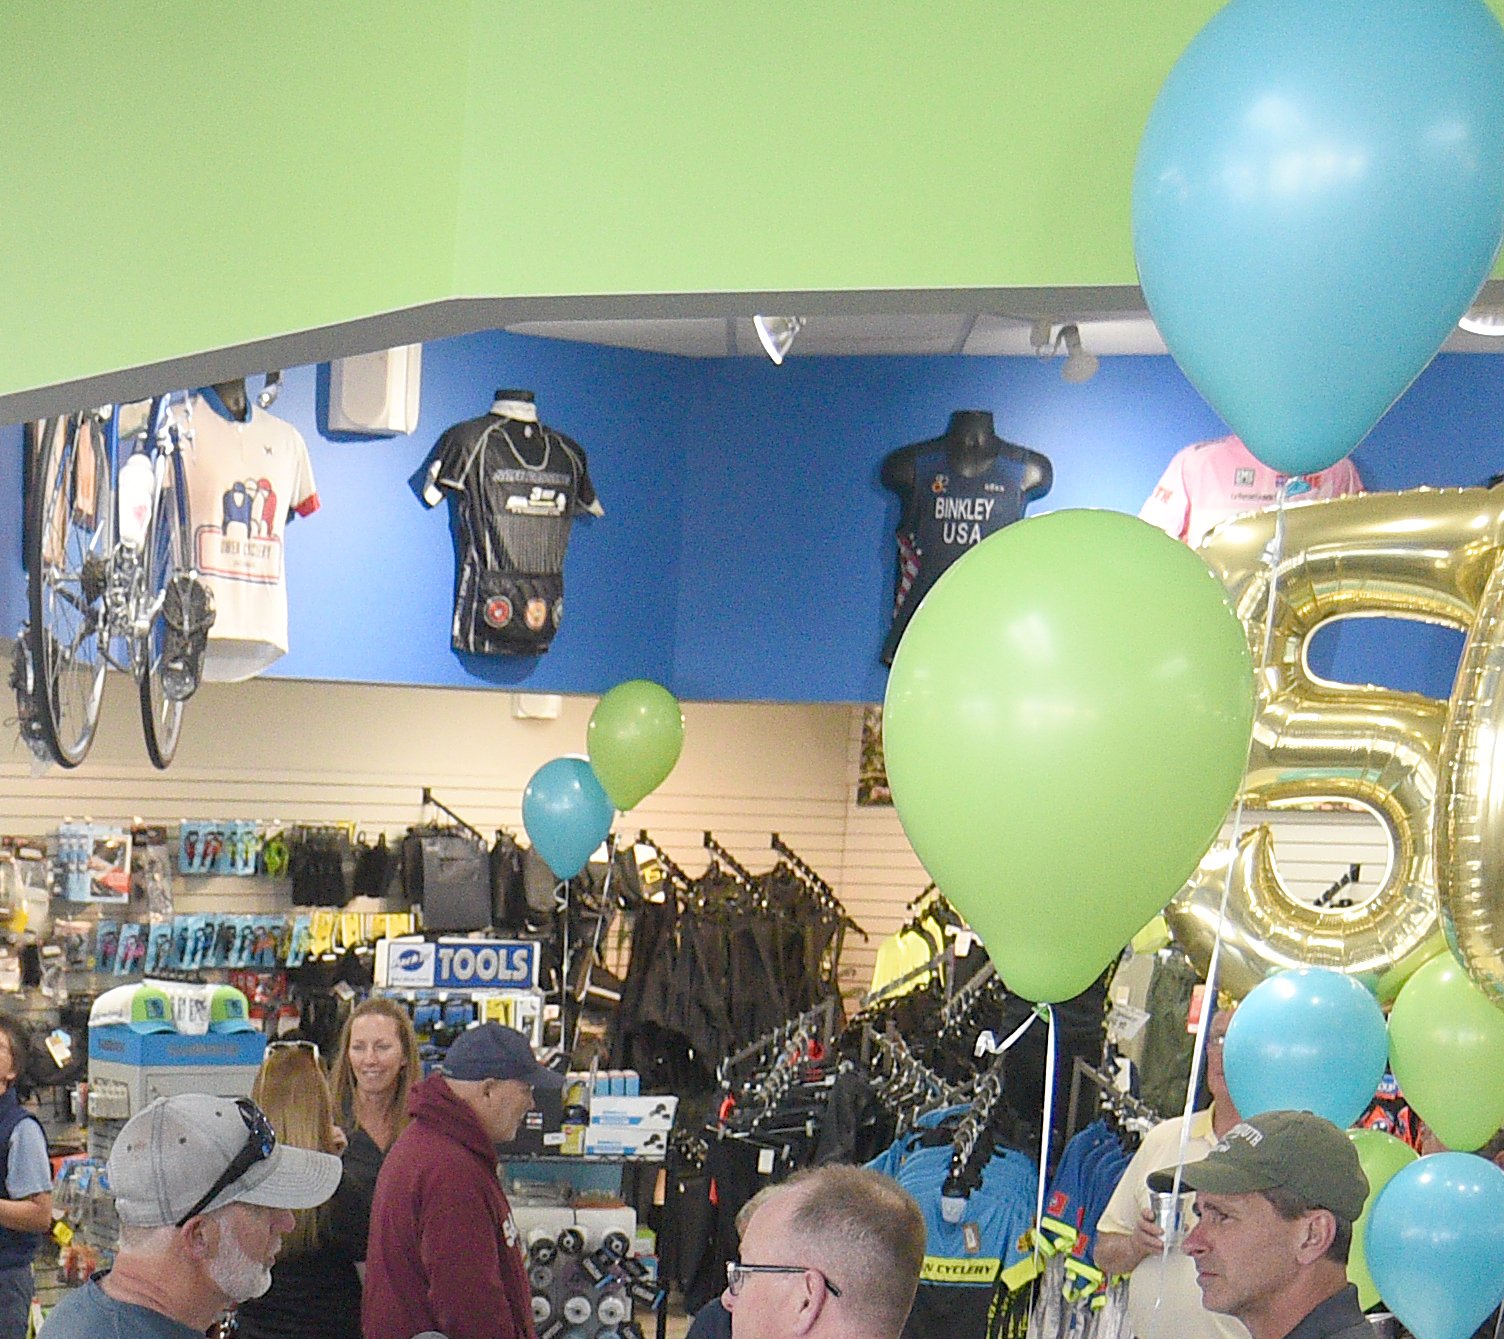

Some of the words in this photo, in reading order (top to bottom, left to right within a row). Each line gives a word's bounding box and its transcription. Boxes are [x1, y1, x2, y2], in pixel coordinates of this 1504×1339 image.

[935, 497, 995, 520] BINKLEY
[943, 522, 981, 544] USA
[438, 948, 529, 981] TOOLS
